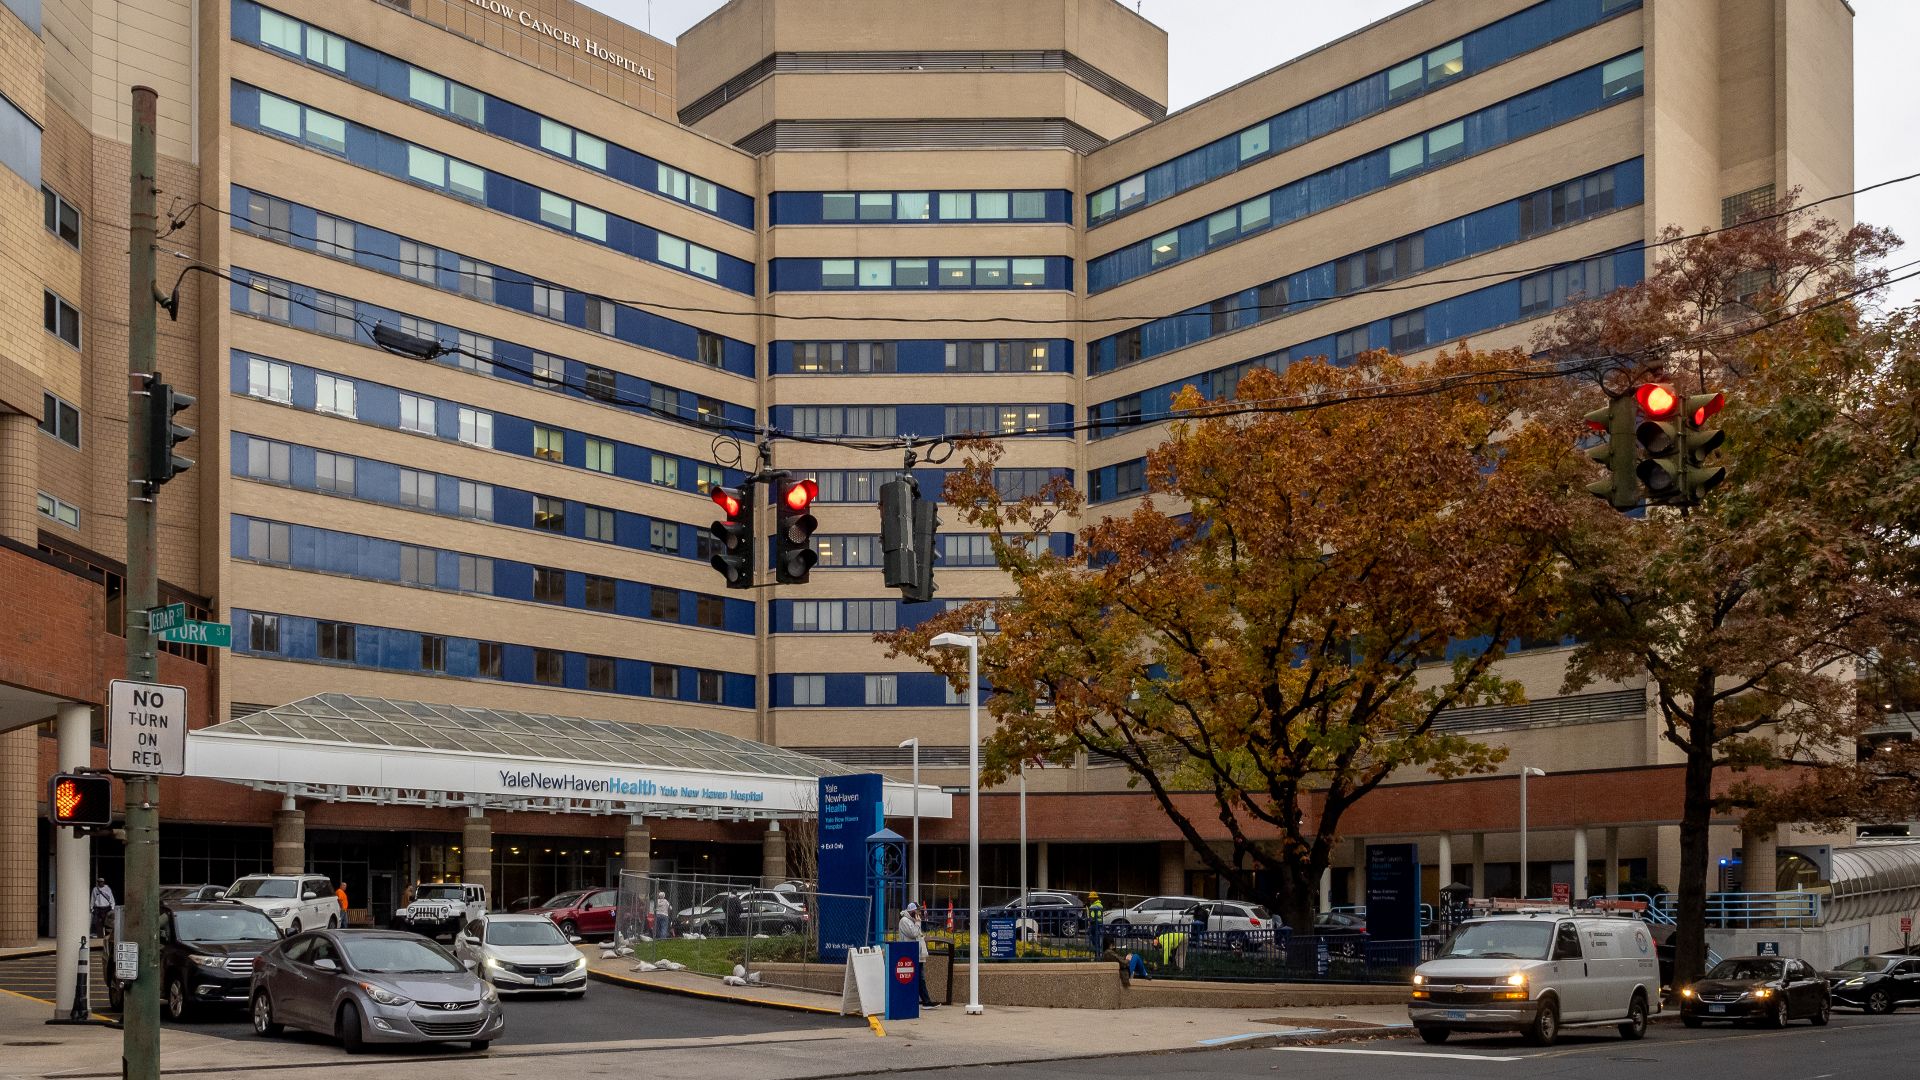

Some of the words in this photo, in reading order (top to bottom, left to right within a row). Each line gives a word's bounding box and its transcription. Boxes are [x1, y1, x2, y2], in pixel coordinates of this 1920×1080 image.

[518, 11, 580, 49] CANCER
[585, 38, 655, 81] HOSPITAL
[152, 609, 175, 631] CEDAR
[176, 607, 183, 618] ST
[216, 627, 226, 636] ST
[133, 690, 164, 709] NO
[128, 711, 168, 729] TURN
[138, 732, 157, 747] ON
[132, 750, 162, 766] RED
[660, 785, 678, 797] Yale
[680, 787, 699, 798] New
[701, 788, 728, 800] Haven
[730, 790, 764, 803] Hospital
[825, 784, 838, 793] Yale
[825, 794, 859, 803] NewHaven
[825, 803, 847, 813] Health
